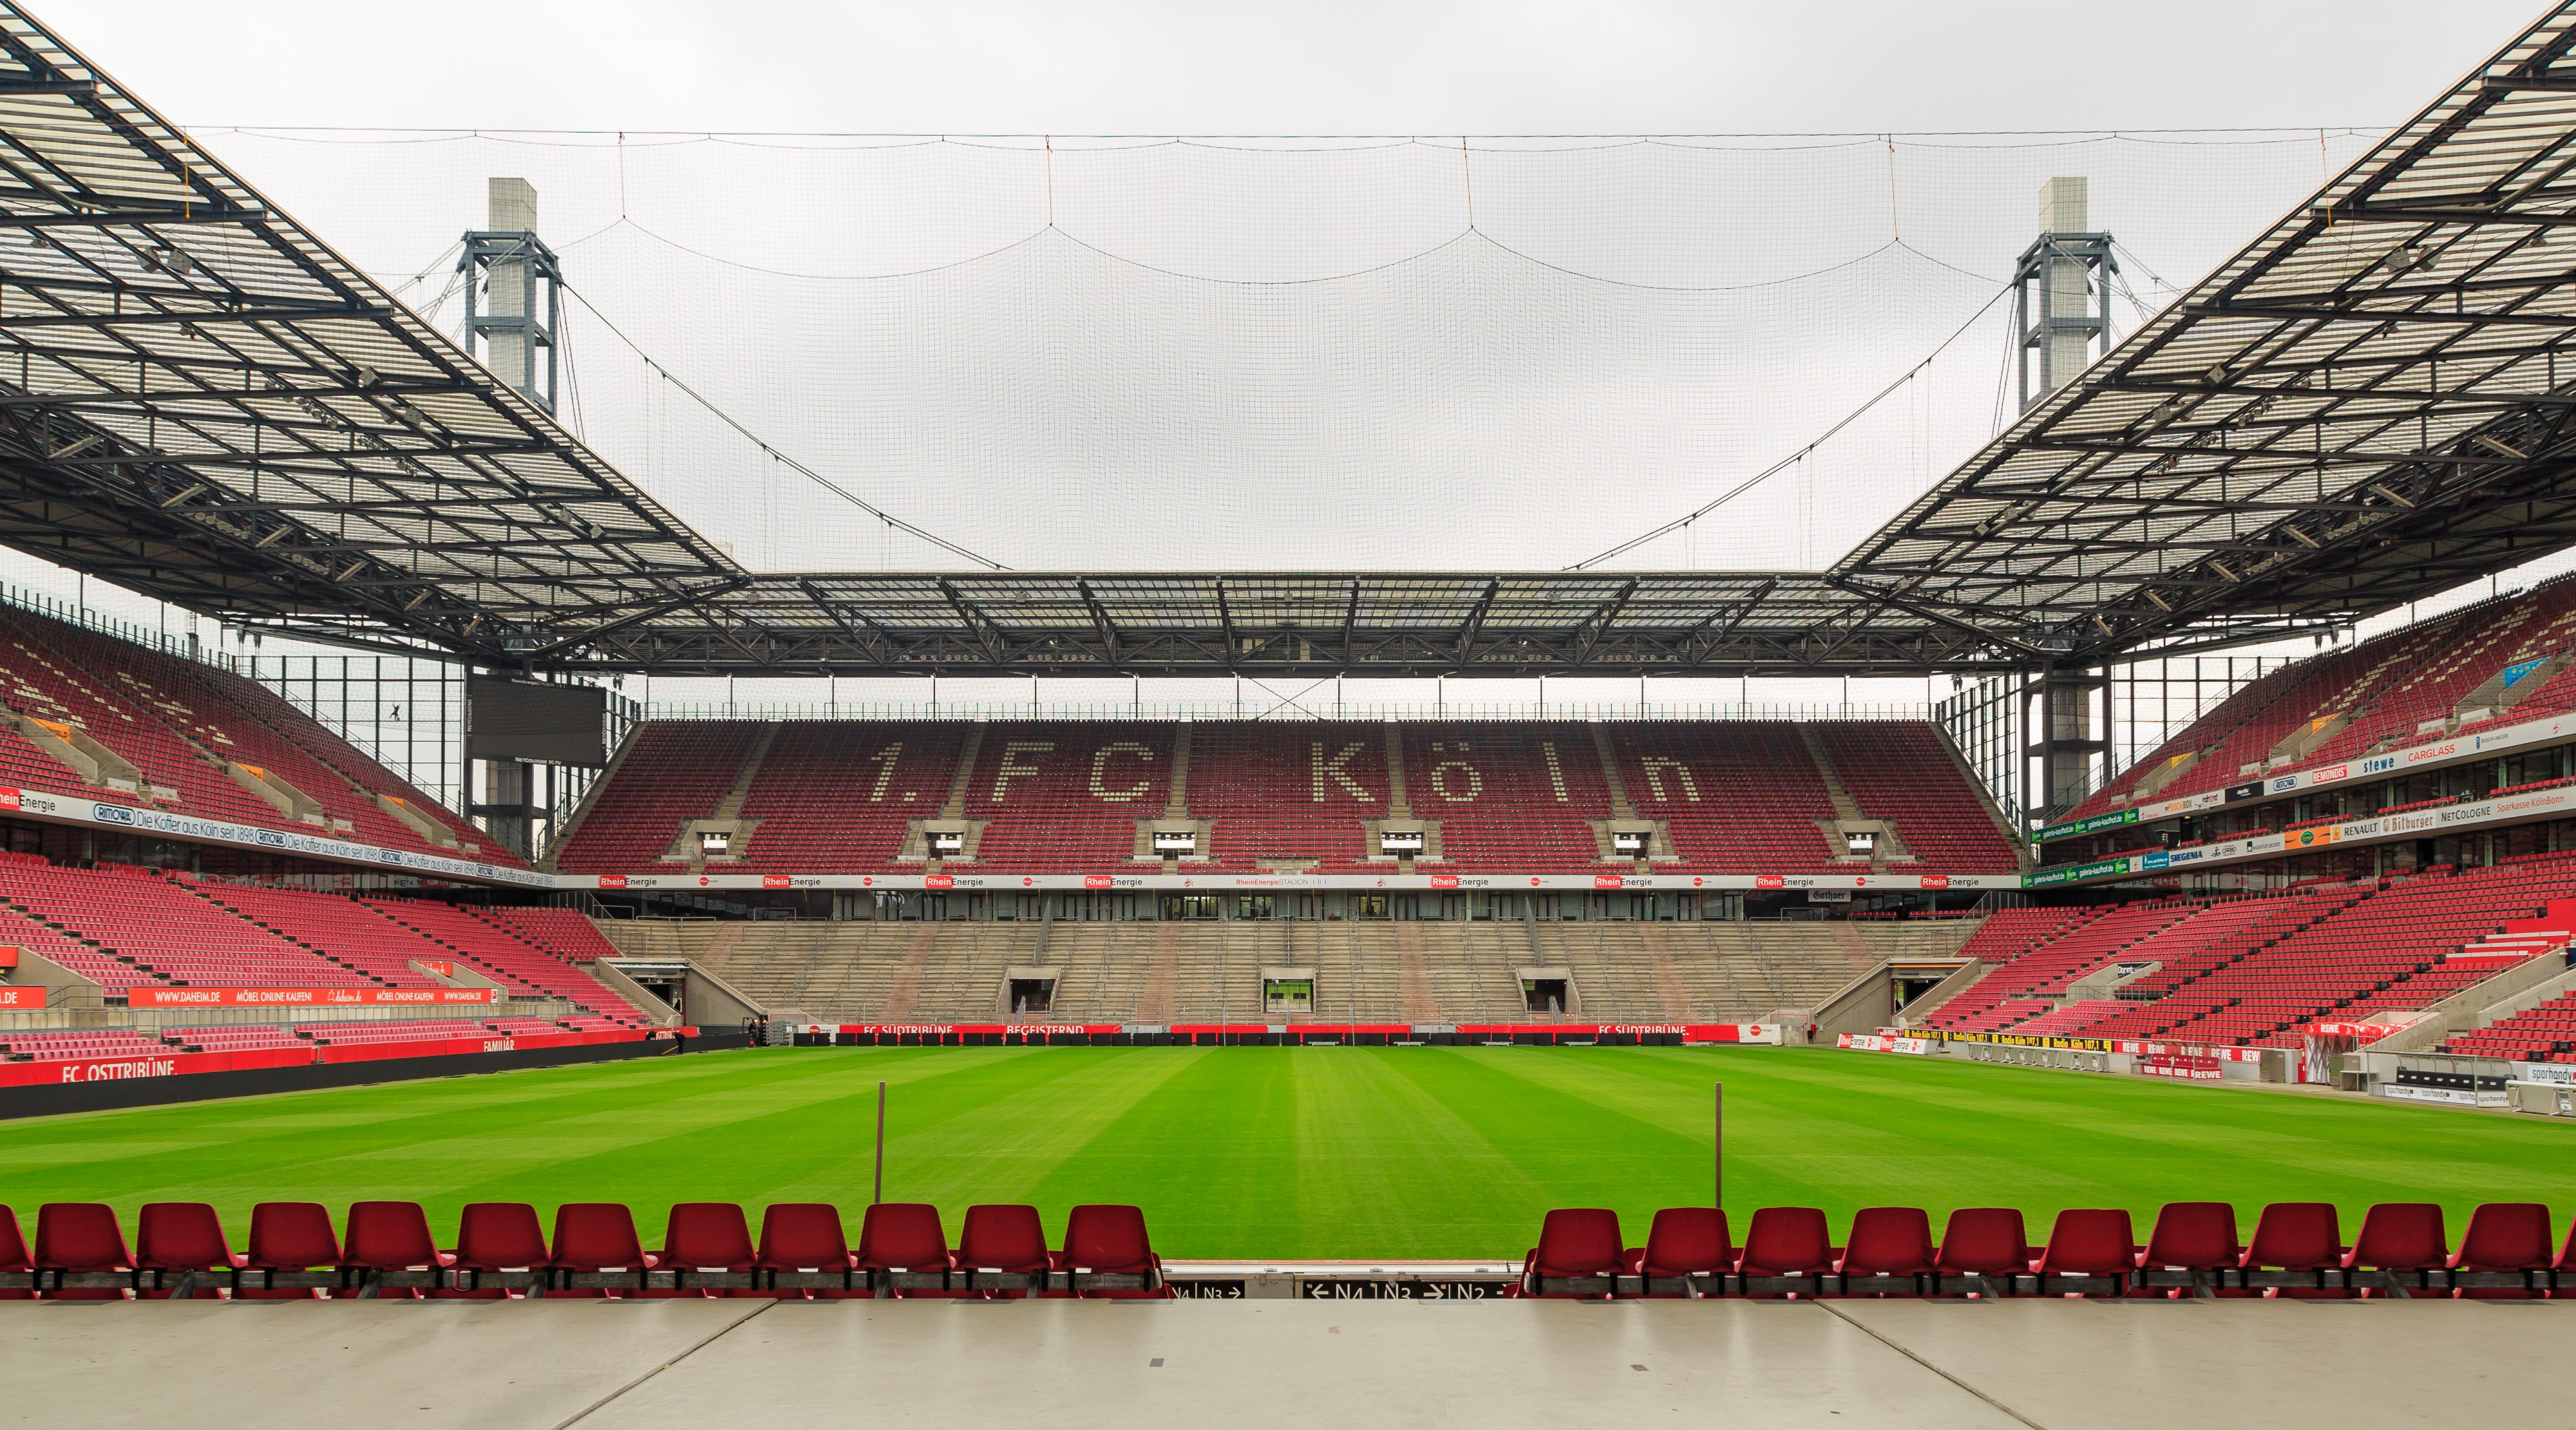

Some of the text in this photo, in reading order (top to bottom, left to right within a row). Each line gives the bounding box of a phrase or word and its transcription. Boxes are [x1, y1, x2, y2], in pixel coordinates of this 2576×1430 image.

[2408, 744, 2456, 762] CARGLASS
[2363, 757, 2394, 773] stewe
[871, 742, 917, 802] 1.
[2313, 767, 2345, 783] REMONDIS
[0, 791, 56, 813] heinEnergie
[2497, 795, 2564, 813] Sparkasse KölnBonn
[2043, 825, 2074, 840] galeria-kaufhof.de
[2088, 814, 2123, 830] galeria-kaufhof.de
[2344, 822, 2378, 836] RENAULT
[2392, 816, 2433, 832] Bitburger
[98, 806, 131, 822] RIMOWA
[137, 811, 153, 828] Die
[155, 814, 181, 832] Koffer
[182, 823, 199, 835] aus
[200, 821, 219, 838] Köln
[220, 826, 235, 840] seit
[236, 826, 254, 843] 1898
[259, 832, 285, 844] RIMOWA
[288, 835, 300, 849] Die
[301, 837, 321, 854] Koffer
[322, 845, 335, 854] aus
[336, 843, 350, 857] Köln
[351, 847, 363, 858] seit
[364, 847, 378, 861] 1898
[381, 852, 401, 862] RIMOWA
[404, 853, 413, 865] Die
[414, 854, 430, 869] Koffer
[430, 861, 441, 870] aus
[442, 859, 453, 872] Köln
[453, 863, 463, 872] seit
[464, 863, 475, 875] 1898
[504, 869, 516, 881] Koffer
[517, 874, 526, 882] aus
[526, 873, 535, 884] Köln
[535, 875, 544, 885] seit
[544, 876, 553, 887] 1898
[2170, 851, 2202, 863] SIEGENIA
[2034, 872, 2065, 885] galeria-kaufhof.de
[2079, 864, 2114, 878] galeria-kaufhof.de
[600, 878, 657, 887] RheinEnergie
[764, 878, 820, 887] RheinEnergie
[927, 878, 983, 887] RheinEnergie
[1086, 878, 1142, 887] RheinEnergie
[1236, 878, 1308, 887] RheinEnergieSTADION
[1432, 878, 1488, 887] RheinEnergie
[1596, 878, 1653, 887] RheinEnergie
[1757, 878, 1814, 887] RheinEnergie
[1922, 878, 1979, 887] RheinEnergie
[1813, 890, 1846, 901] Gothaer
[155, 989, 482, 1002] WWW.DAHEIM.DE MÖBEL ONLINE KAUFEN! daheim.de MÖBEL ONLINE KAUFEN! WWW.DAHEIM.DE
[2320, 1024, 2340, 1033] REWE
[1840, 1035, 1865, 1048] RheinEnergie
[1922, 1031, 1931, 1039] Köln
[1931, 1031, 1941, 1040] 107,1
[1953, 1031, 1987, 1043] Radio Köln 107,1
[2002, 1035, 2014, 1045] Radio
[2015, 1036, 2025, 1046] Köln
[1880, 1037, 1909, 1052] RheinEnergie
[2053, 1038, 2099, 1051] Radio Köln 107,1
[2123, 1042, 2139, 1053] REWE
[2148, 1044, 2165, 1054] REWE
[2211, 1048, 2231, 1060] REWE
[2242, 1050, 2260, 1062] REW
[2144, 1064, 2157, 1074] REWE
[2159, 1066, 2172, 1075] REWE
[2174, 1068, 2188, 1077] REWE
[2195, 1071, 2221, 1079] REWE
[2532, 1067, 2572, 1082] sparhandy
[2387, 1086, 2476, 1101] sparhandy sparhandy sparha
[2478, 1095, 2506, 1104] sparhandy
[1204, 1287, 1222, 1299] N3
[1386, 1284, 1411, 1299] N3
[1458, 1284, 1484, 1299] N2
